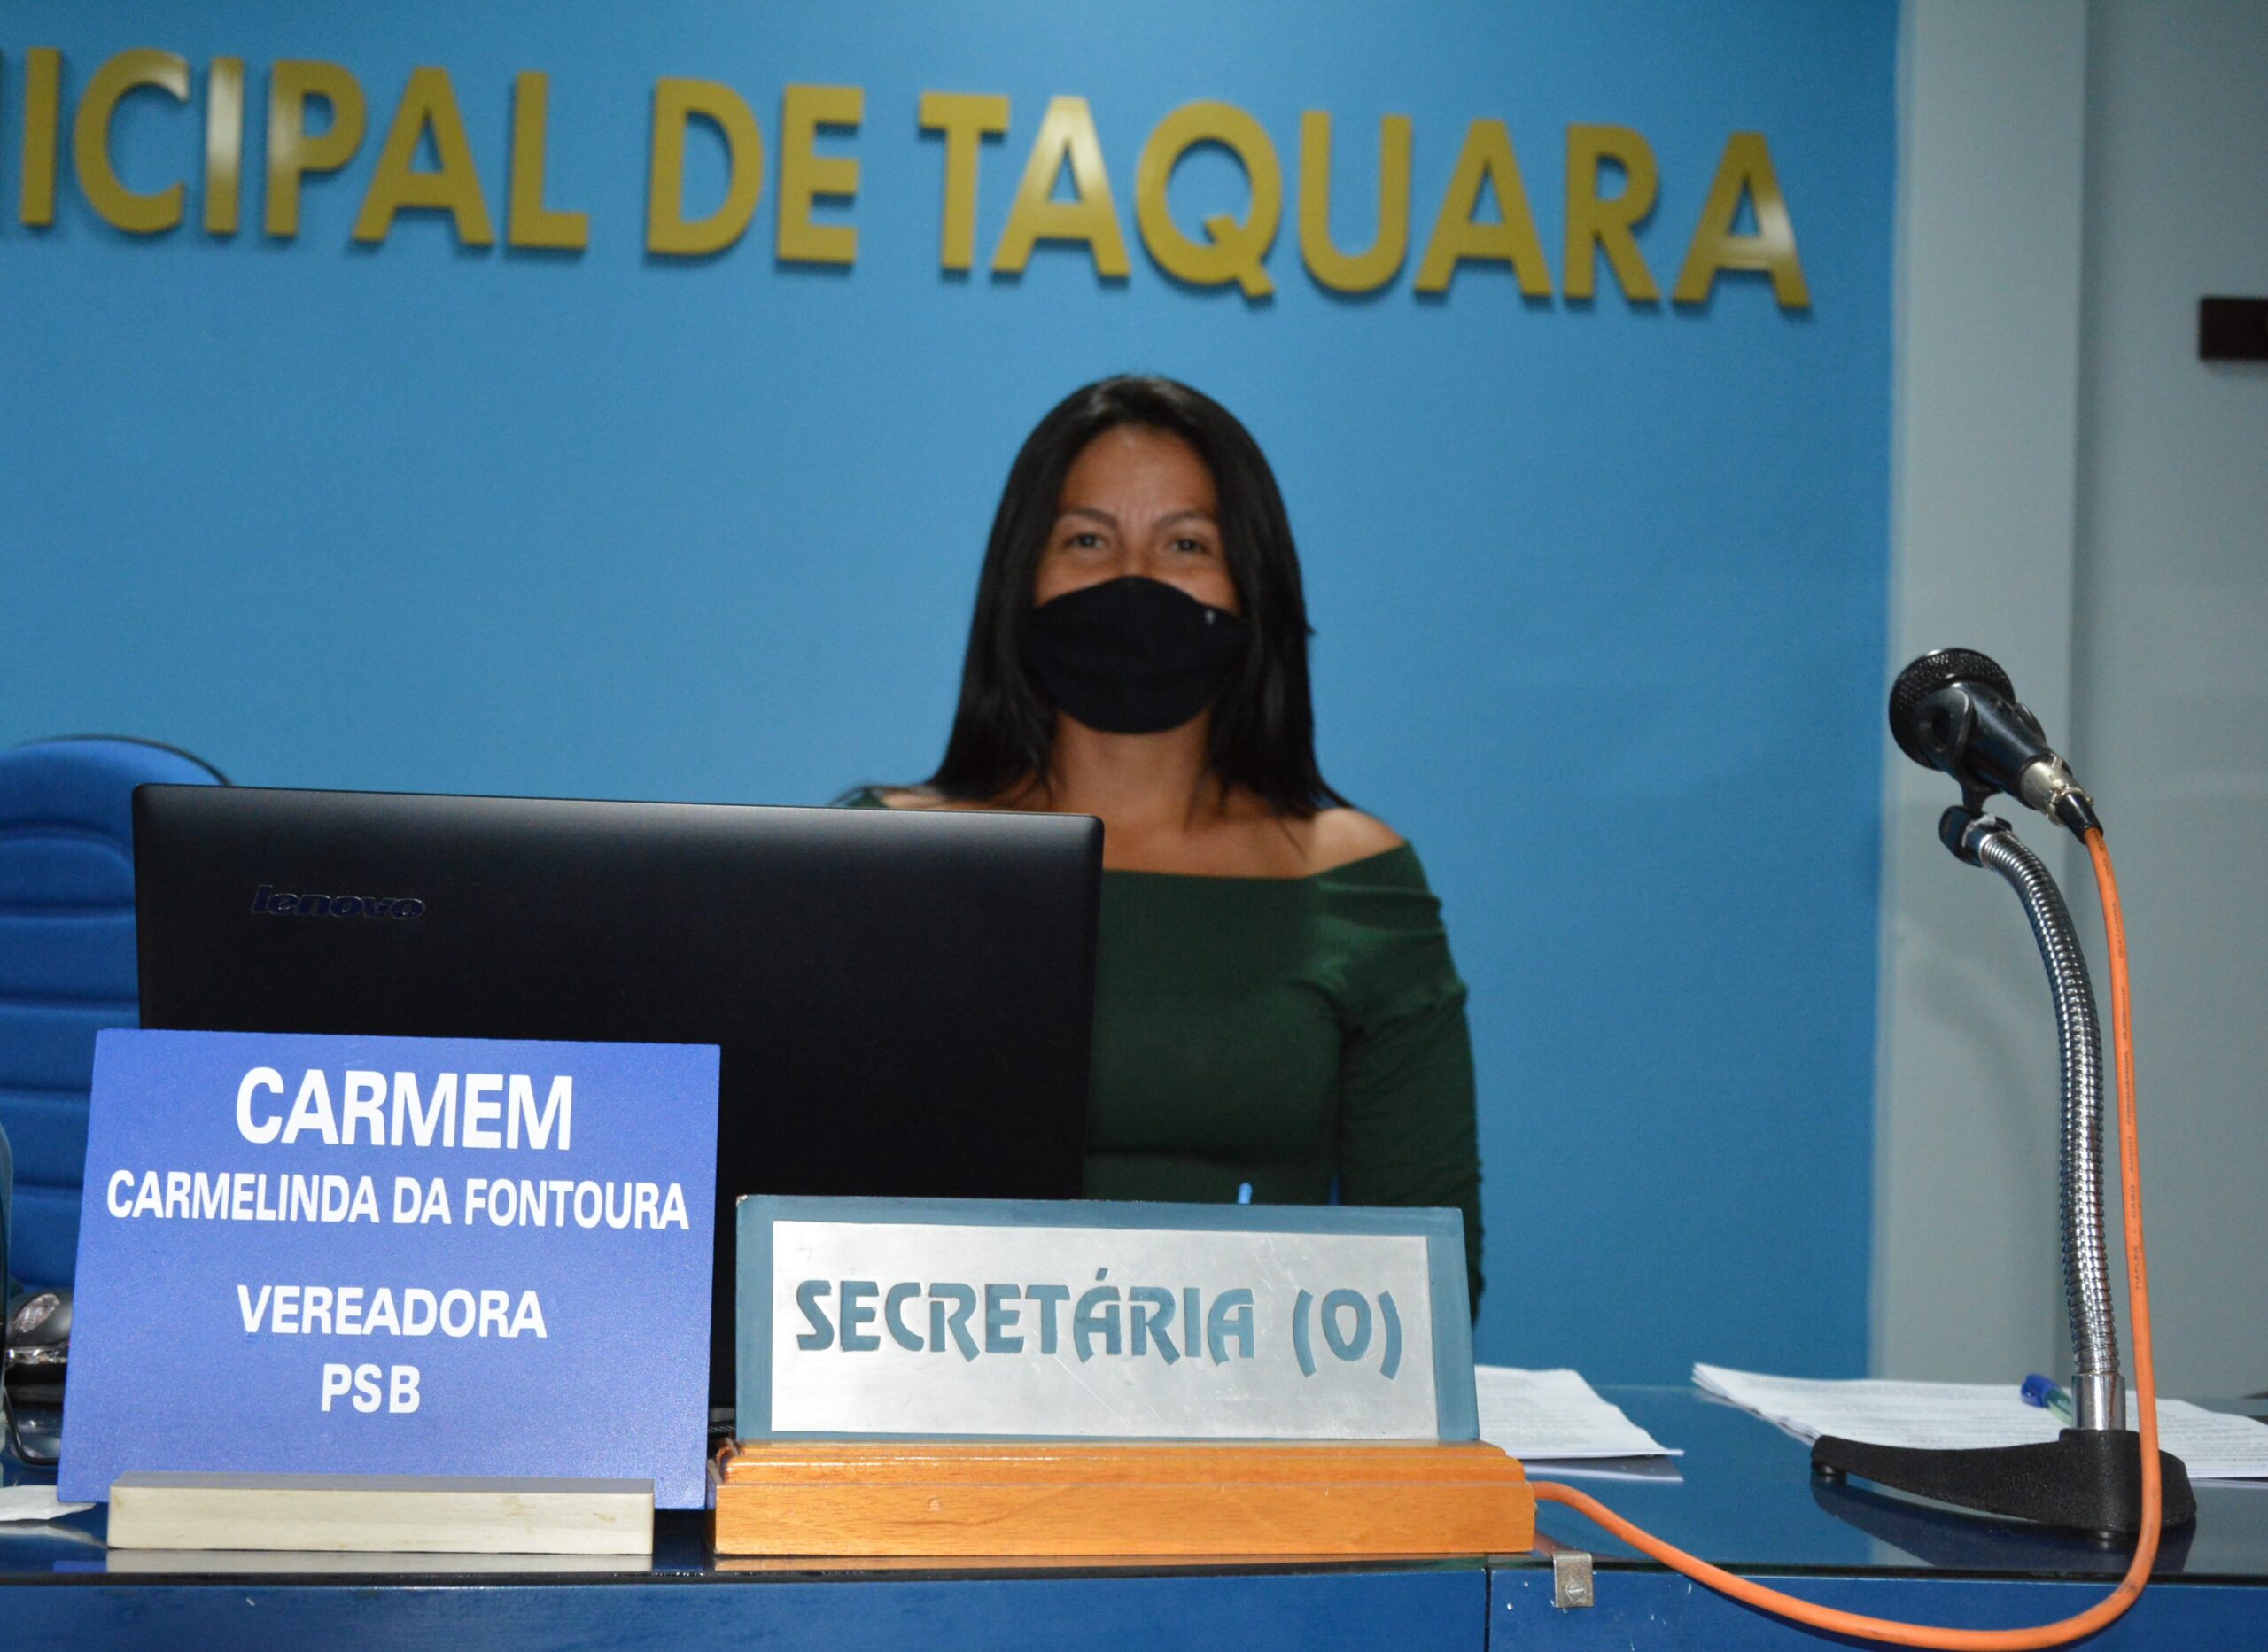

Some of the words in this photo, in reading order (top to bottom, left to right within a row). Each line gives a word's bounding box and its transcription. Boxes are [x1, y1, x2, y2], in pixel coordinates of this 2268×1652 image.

[646, 76, 864, 264] DE
[919, 91, 1811, 307] TAQUARA
[252, 884, 425, 920] lenovo
[236, 1066, 573, 1151] CARMEM
[106, 1169, 380, 1223] CARMELINDA
[392, 1177, 452, 1224] DA
[464, 1179, 690, 1230] FONTOURA
[237, 1284, 548, 1338] VEREADORA
[796, 1268, 1254, 1365] SECRETÁRIA
[321, 1363, 421, 1415] PSB
